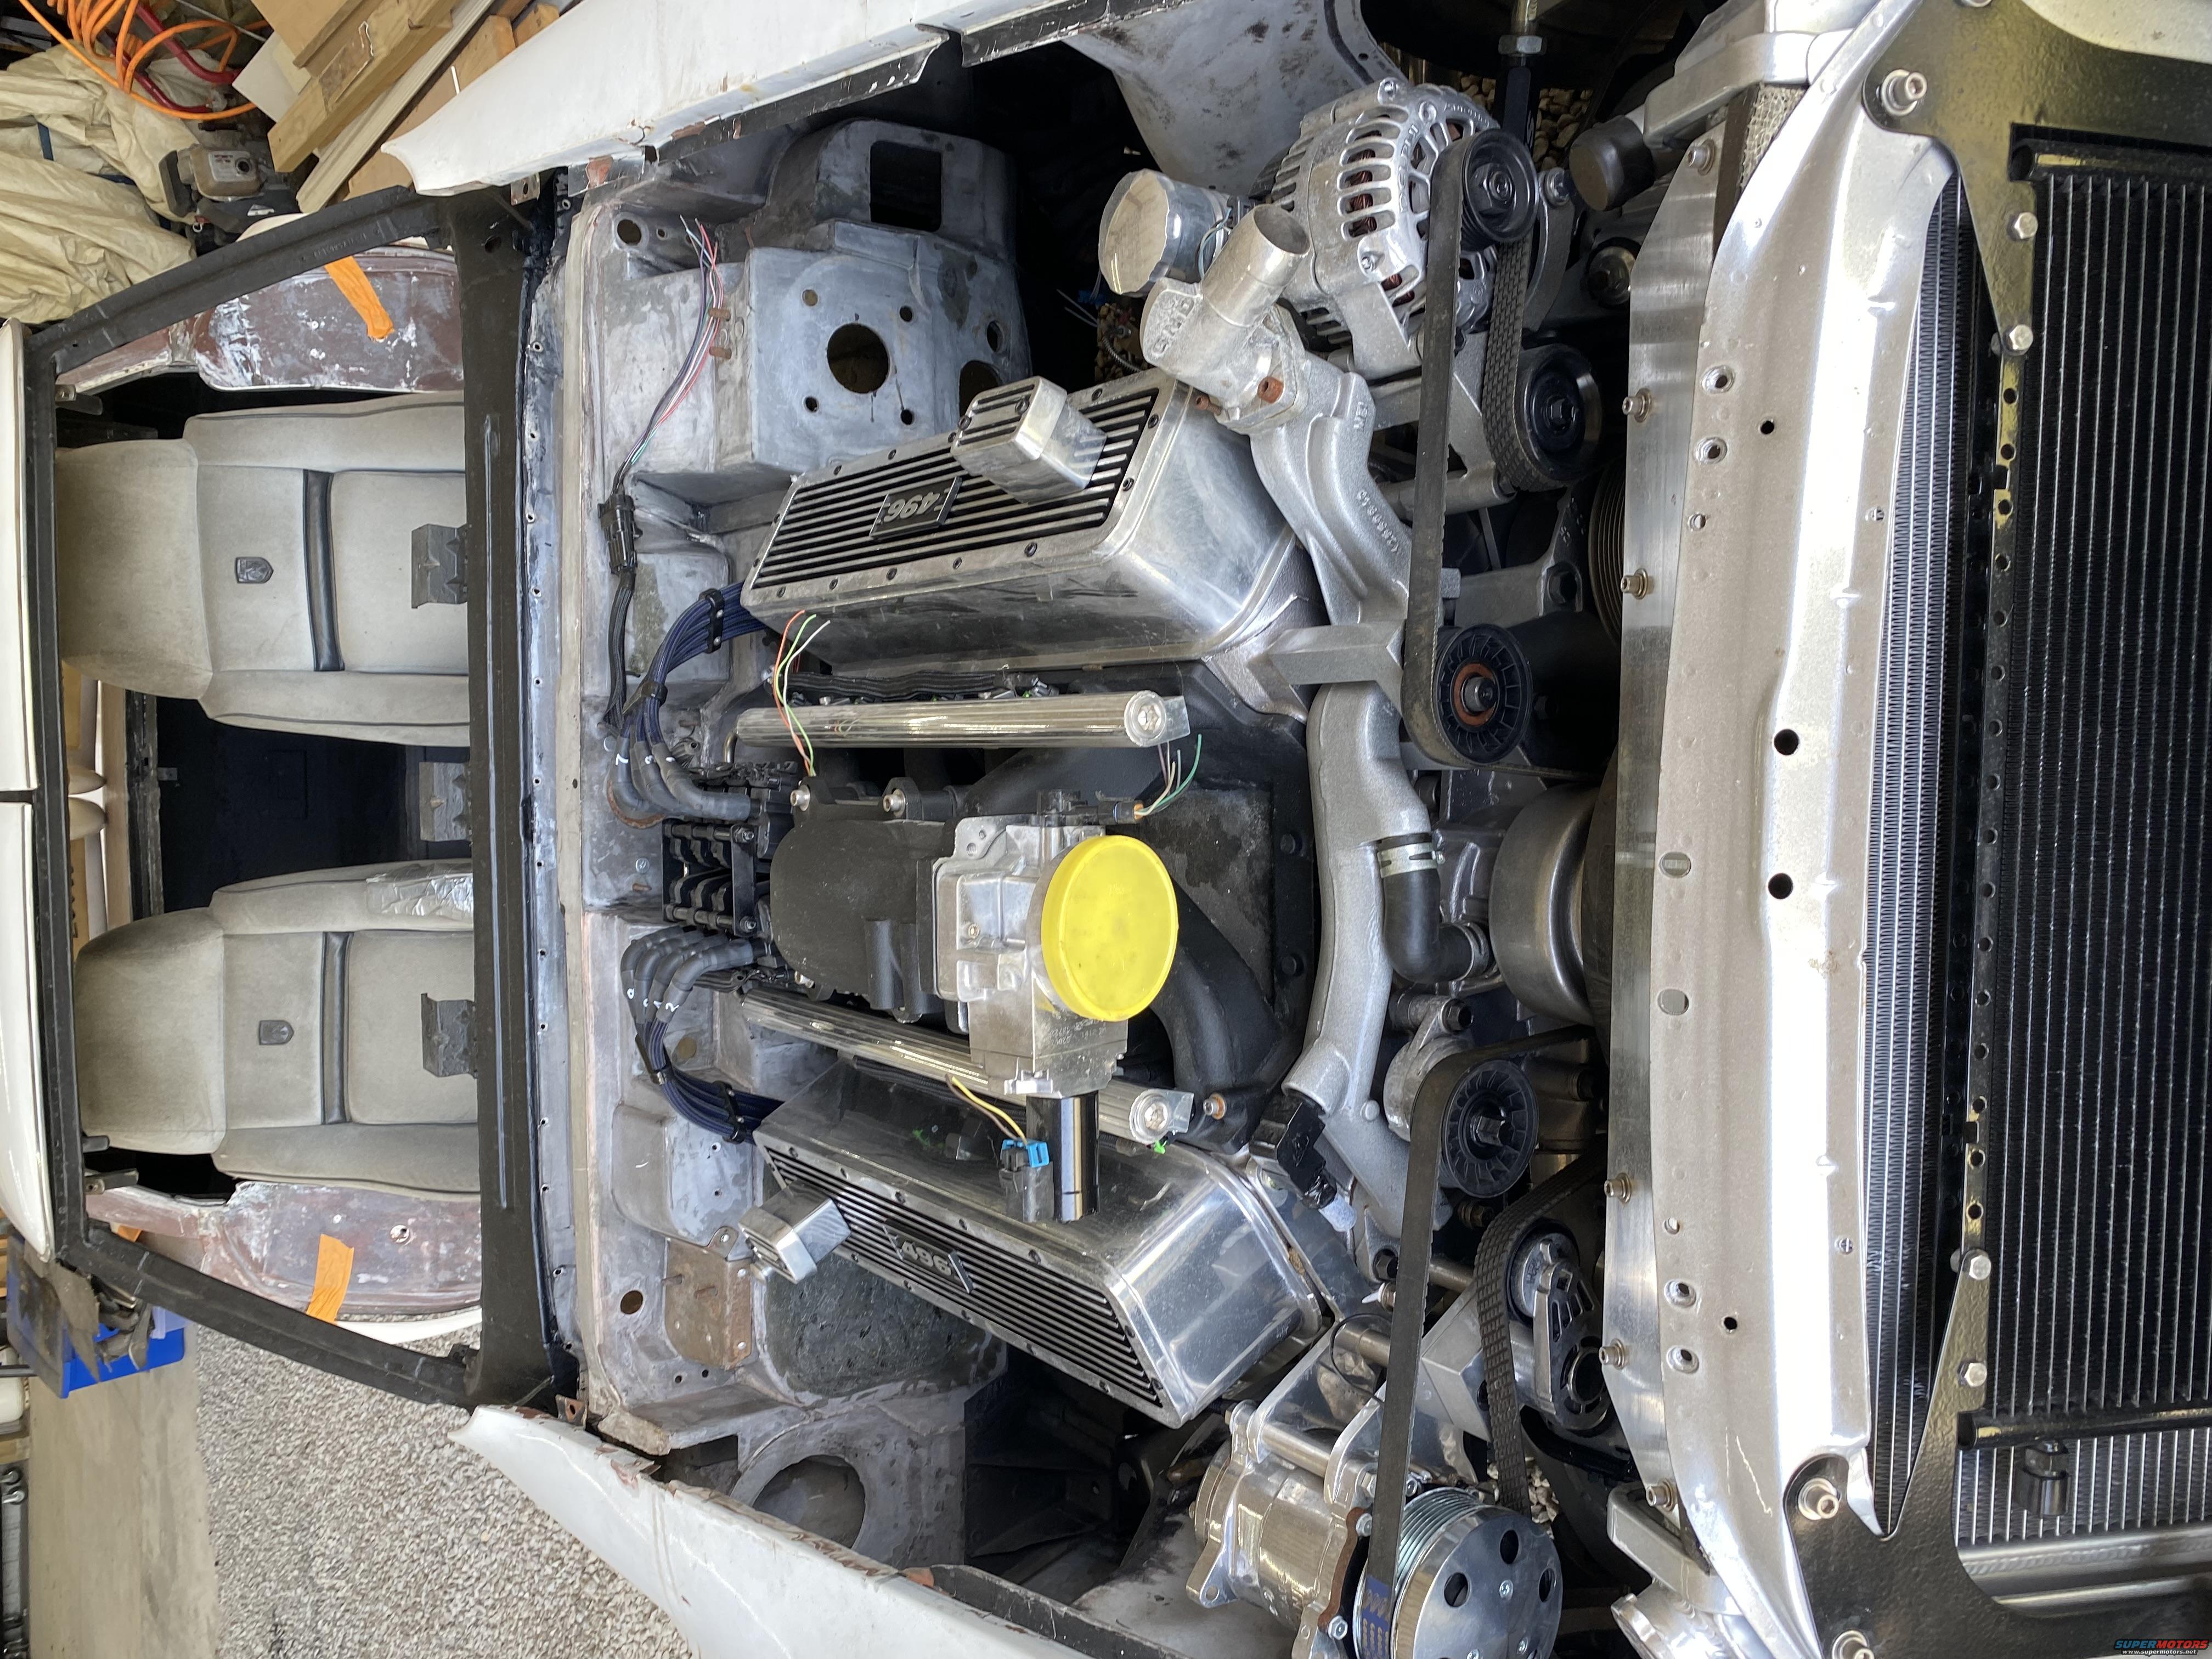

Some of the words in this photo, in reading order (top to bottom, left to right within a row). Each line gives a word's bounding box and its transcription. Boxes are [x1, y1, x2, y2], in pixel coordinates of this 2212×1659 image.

[1398, 123, 1418, 212] DELPHI
[883, 492, 940, 522] 496
[901, 1240, 951, 1276] 496
